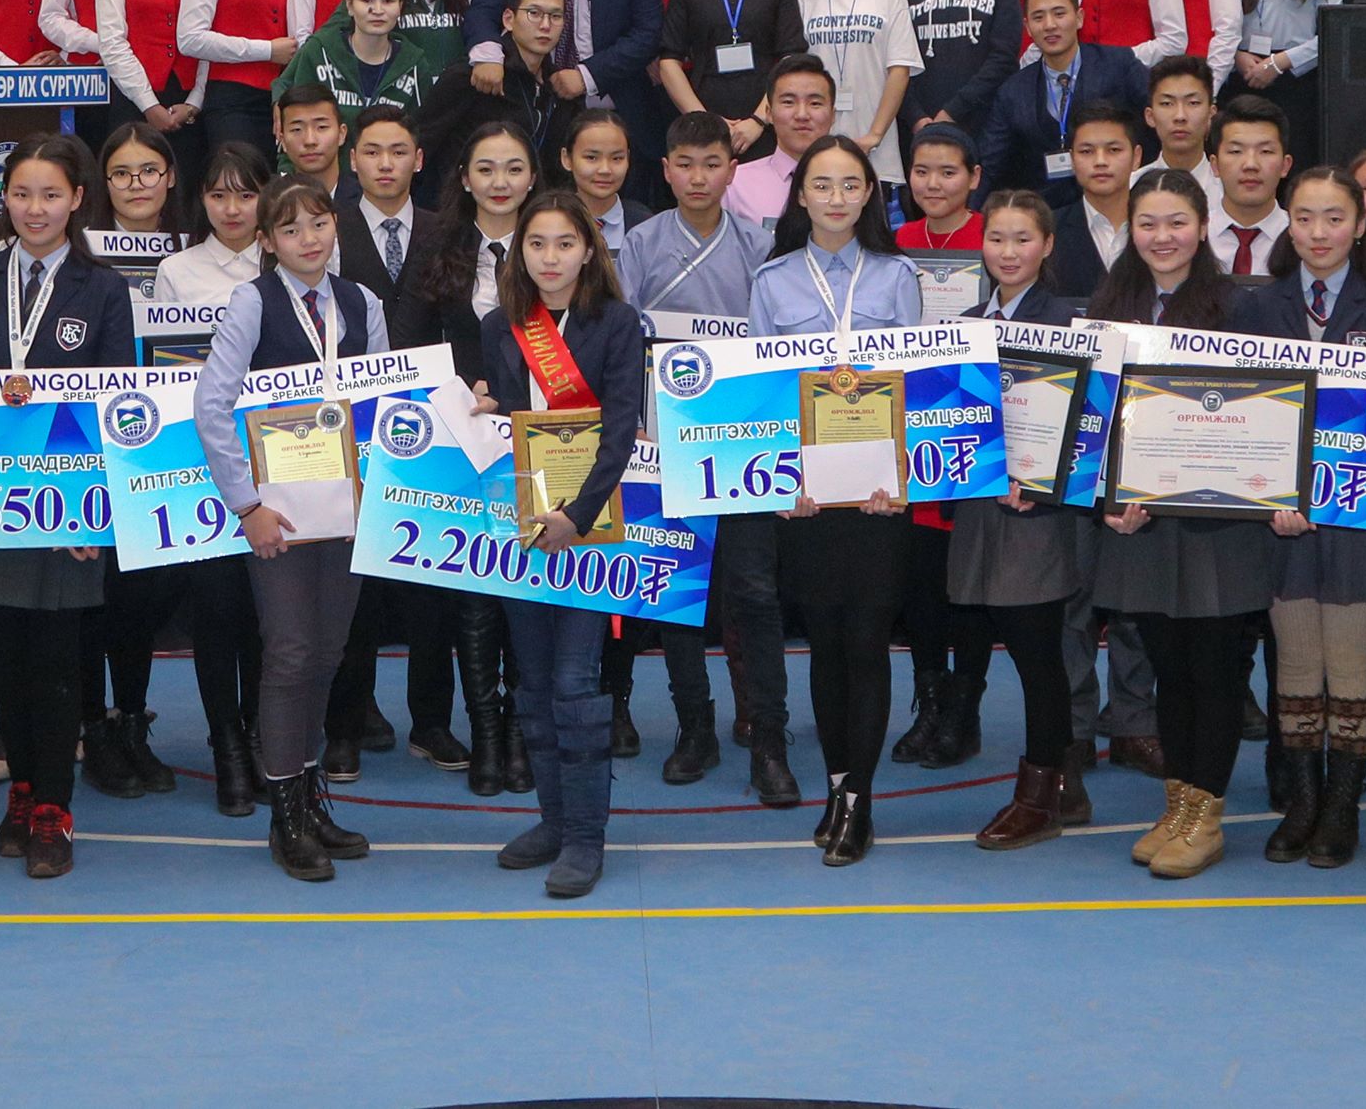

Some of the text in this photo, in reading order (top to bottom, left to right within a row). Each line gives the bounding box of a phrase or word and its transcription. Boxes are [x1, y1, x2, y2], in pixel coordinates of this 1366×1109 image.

[18, 75, 37, 98] ИХ
[40, 74, 106, 97] СУРГУУЛЬ
[904, 329, 970, 350] PUPIL
[1050, 331, 1102, 352] PUPIL
[1170, 332, 1311, 364] MONGOLIAN
[888, 346, 971, 360] CHAMPIONSHIP
[351, 355, 418, 378] PUPIL
[337, 372, 420, 392] CHAMPIONSHIP
[680, 424, 751, 442] ИЛТГЭХ
[757, 422, 779, 437] УР
[129, 468, 205, 492] ИЛТГЭХ
[384, 486, 456, 511] ИЛТГЭХ
